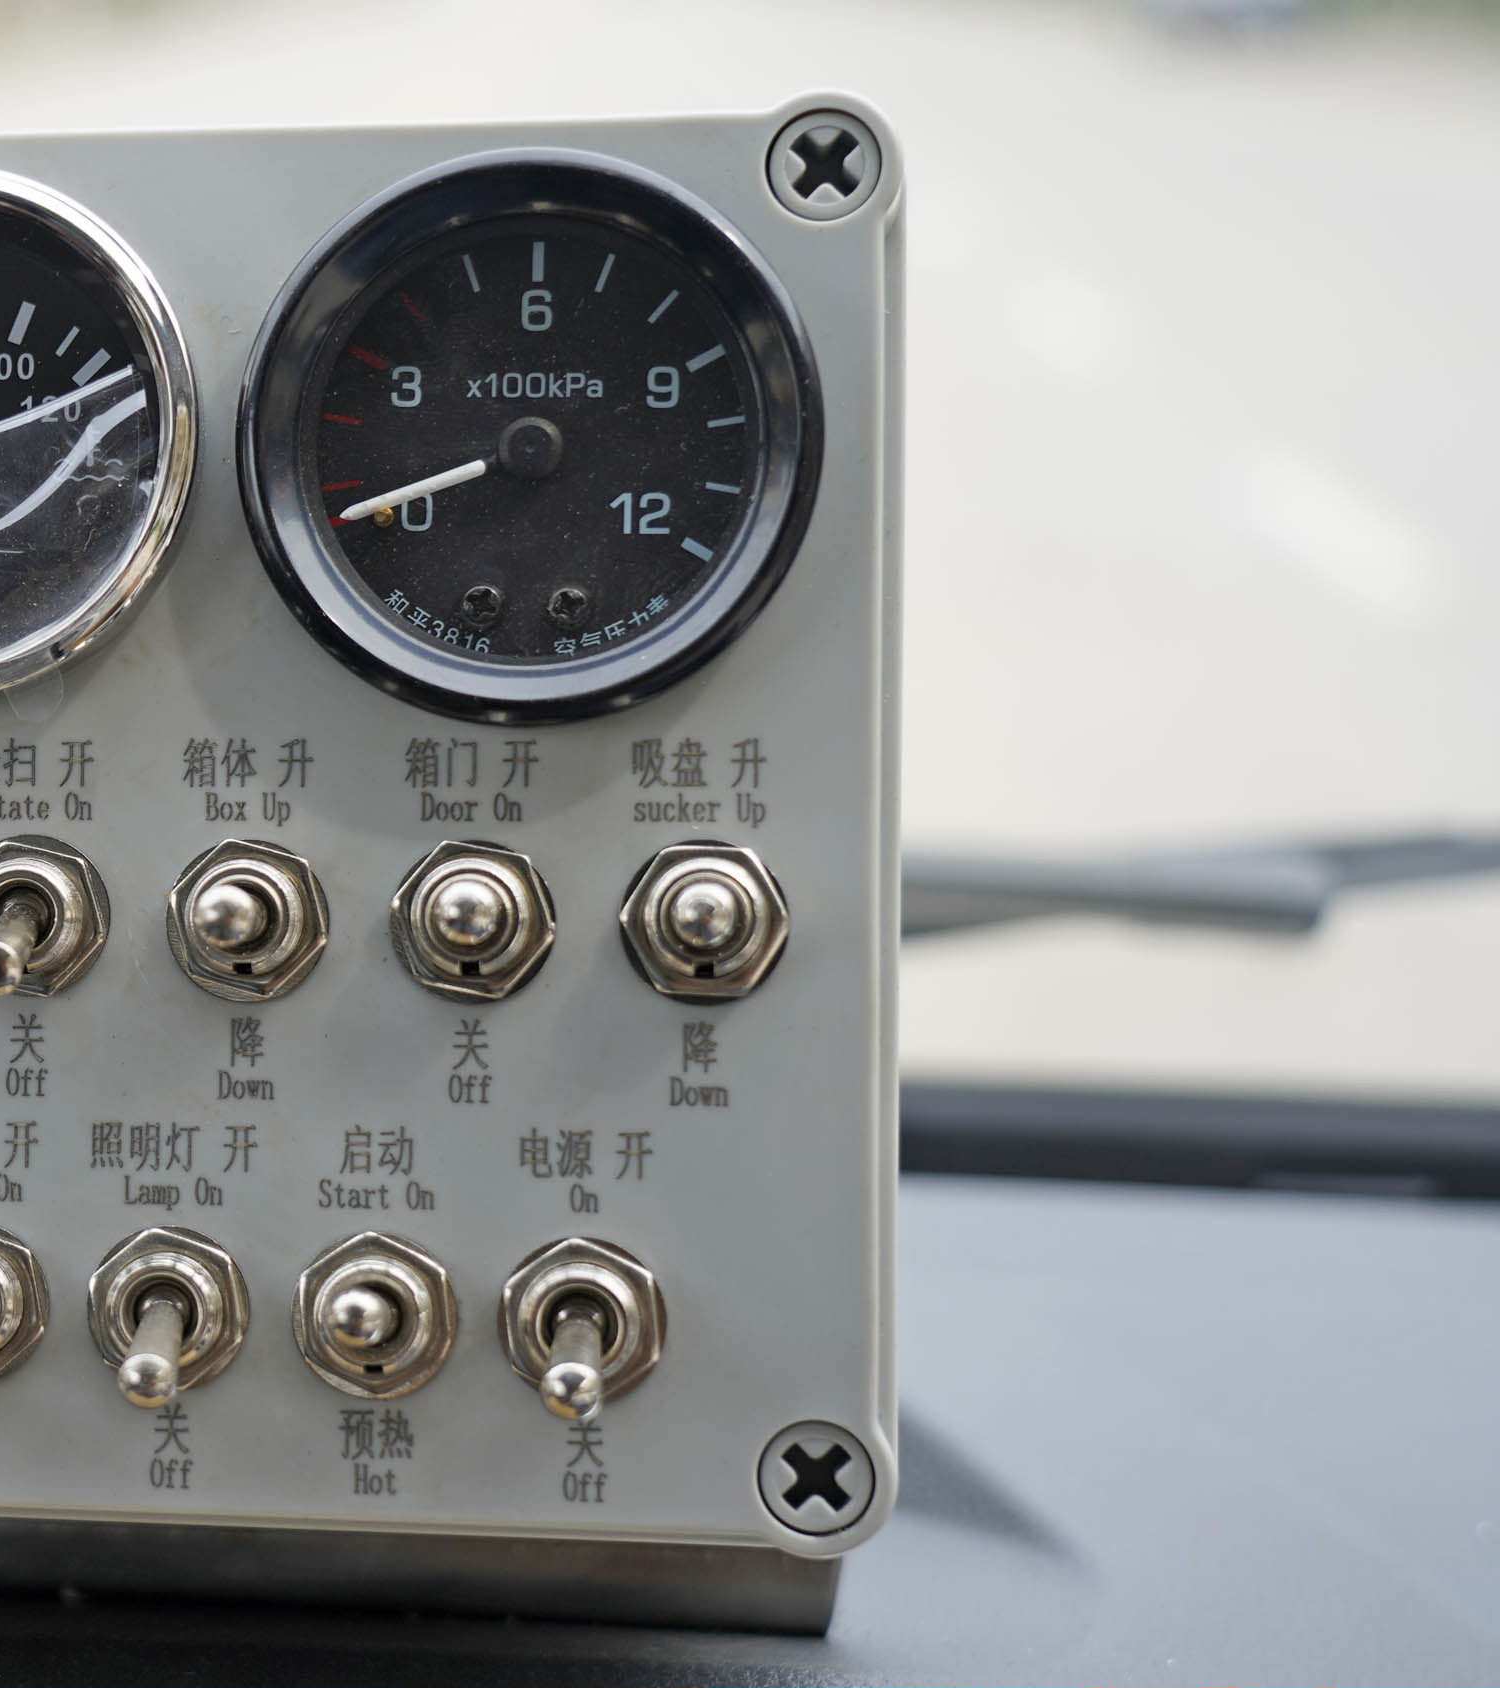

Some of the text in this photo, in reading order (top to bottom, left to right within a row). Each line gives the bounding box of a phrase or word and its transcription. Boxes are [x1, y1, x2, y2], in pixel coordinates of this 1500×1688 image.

[520, 290, 552, 331] 6
[390, 366, 422, 407] 3
[466, 373, 605, 399] x100kPa
[646, 366, 680, 408] 9
[399, 493, 433, 531] 0
[609, 493, 670, 535] 12
[60, 740, 94, 787] 开
[183, 738, 314, 788] 箱体 升
[404, 737, 539, 789] 箱门 开
[632, 737, 767, 789] 吸盘 升
[65, 792, 92, 821] On
[205, 792, 291, 827] Box Up
[420, 792, 523, 822] Door On
[633, 792, 766, 829] sucker Up
[9, 1015, 44, 1065] 关
[230, 1016, 264, 1068] 降
[452, 1019, 489, 1071] 关
[682, 1021, 718, 1074] 降
[6, 1067, 48, 1097] Off
[217, 1070, 275, 1100] Down
[448, 1074, 492, 1104] Off
[669, 1076, 729, 1108] Down
[4, 1121, 39, 1168] 开
[90, 1122, 258, 1173] 照明灯 开
[340, 1125, 414, 1176] 启动
[519, 1127, 654, 1180] 电源 开
[124, 1175, 223, 1211] Lamp On
[318, 1179, 435, 1211] Start On
[570, 1182, 599, 1214] On
[151, 1403, 190, 1455] 关
[338, 1408, 414, 1461] 预热
[566, 1420, 604, 1468] 关
[150, 1458, 193, 1490] Off
[353, 1462, 397, 1496] Hot
[563, 1471, 607, 1503] Off
